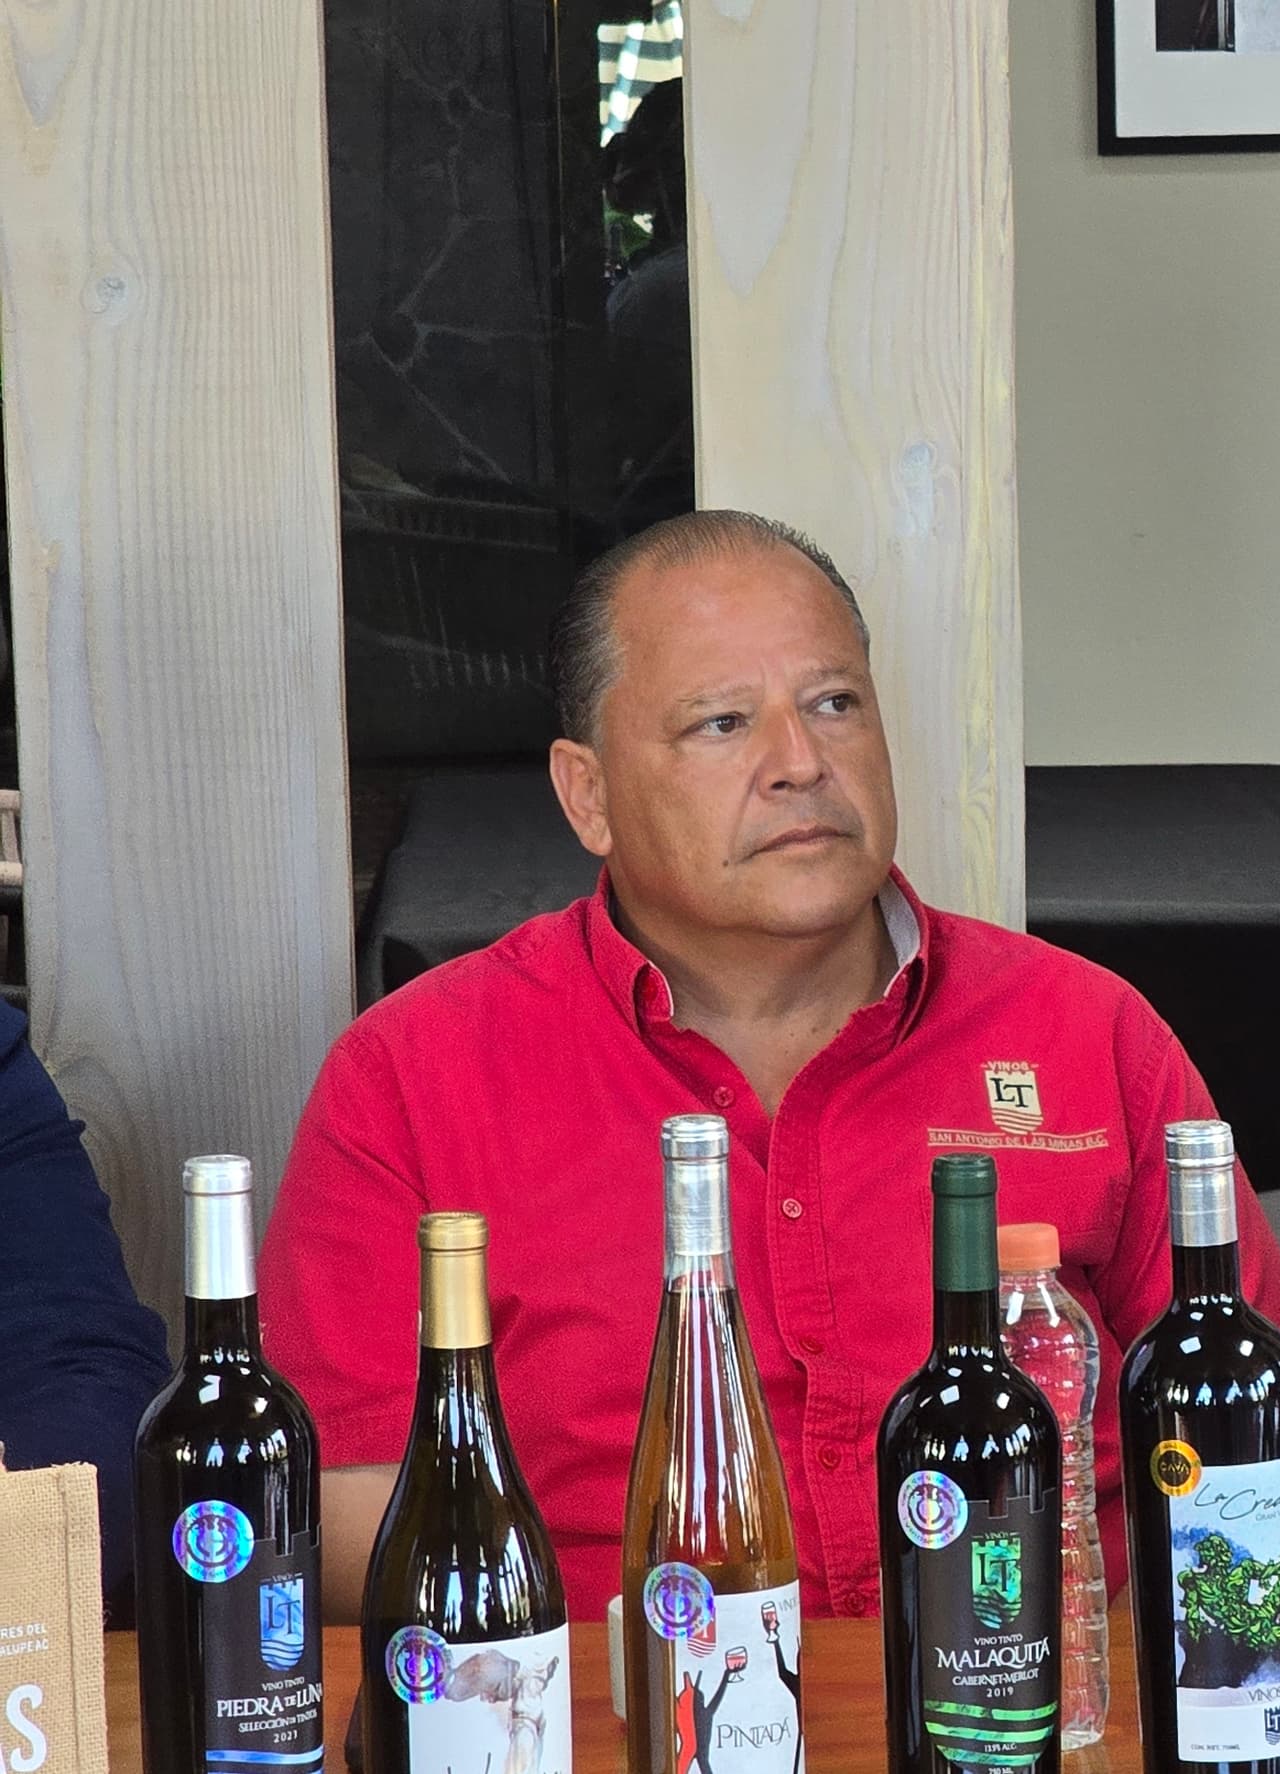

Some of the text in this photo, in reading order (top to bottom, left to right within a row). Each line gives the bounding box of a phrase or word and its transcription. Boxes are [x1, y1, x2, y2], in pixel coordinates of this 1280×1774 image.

[987, 1061, 1029, 1071] VINOS
[990, 1077, 1033, 1108] LT
[929, 1131, 952, 1143] SAN
[955, 1133, 1003, 1146] ANTONIO
[1005, 1136, 1020, 1147] DE
[1023, 1137, 1045, 1148] LAS
[1048, 1137, 1083, 1150] MINAS
[976, 1553, 1016, 1592] LT
[265, 1596, 300, 1635] LT
[26, 1623, 47, 1635] DEL
[974, 1633, 1023, 1646] VINO TINTO
[934, 1636, 1050, 1672] MALAQUITA
[262, 1676, 305, 1691] VINO TINTO
[986, 1686, 1014, 1698] 2019
[217, 1696, 284, 1717] PIEDRA
[284, 1695, 296, 1706] DE
[0, 1684, 47, 1773] S
[273, 1730, 298, 1743] 2021
[717, 1716, 791, 1749] PINTADA
